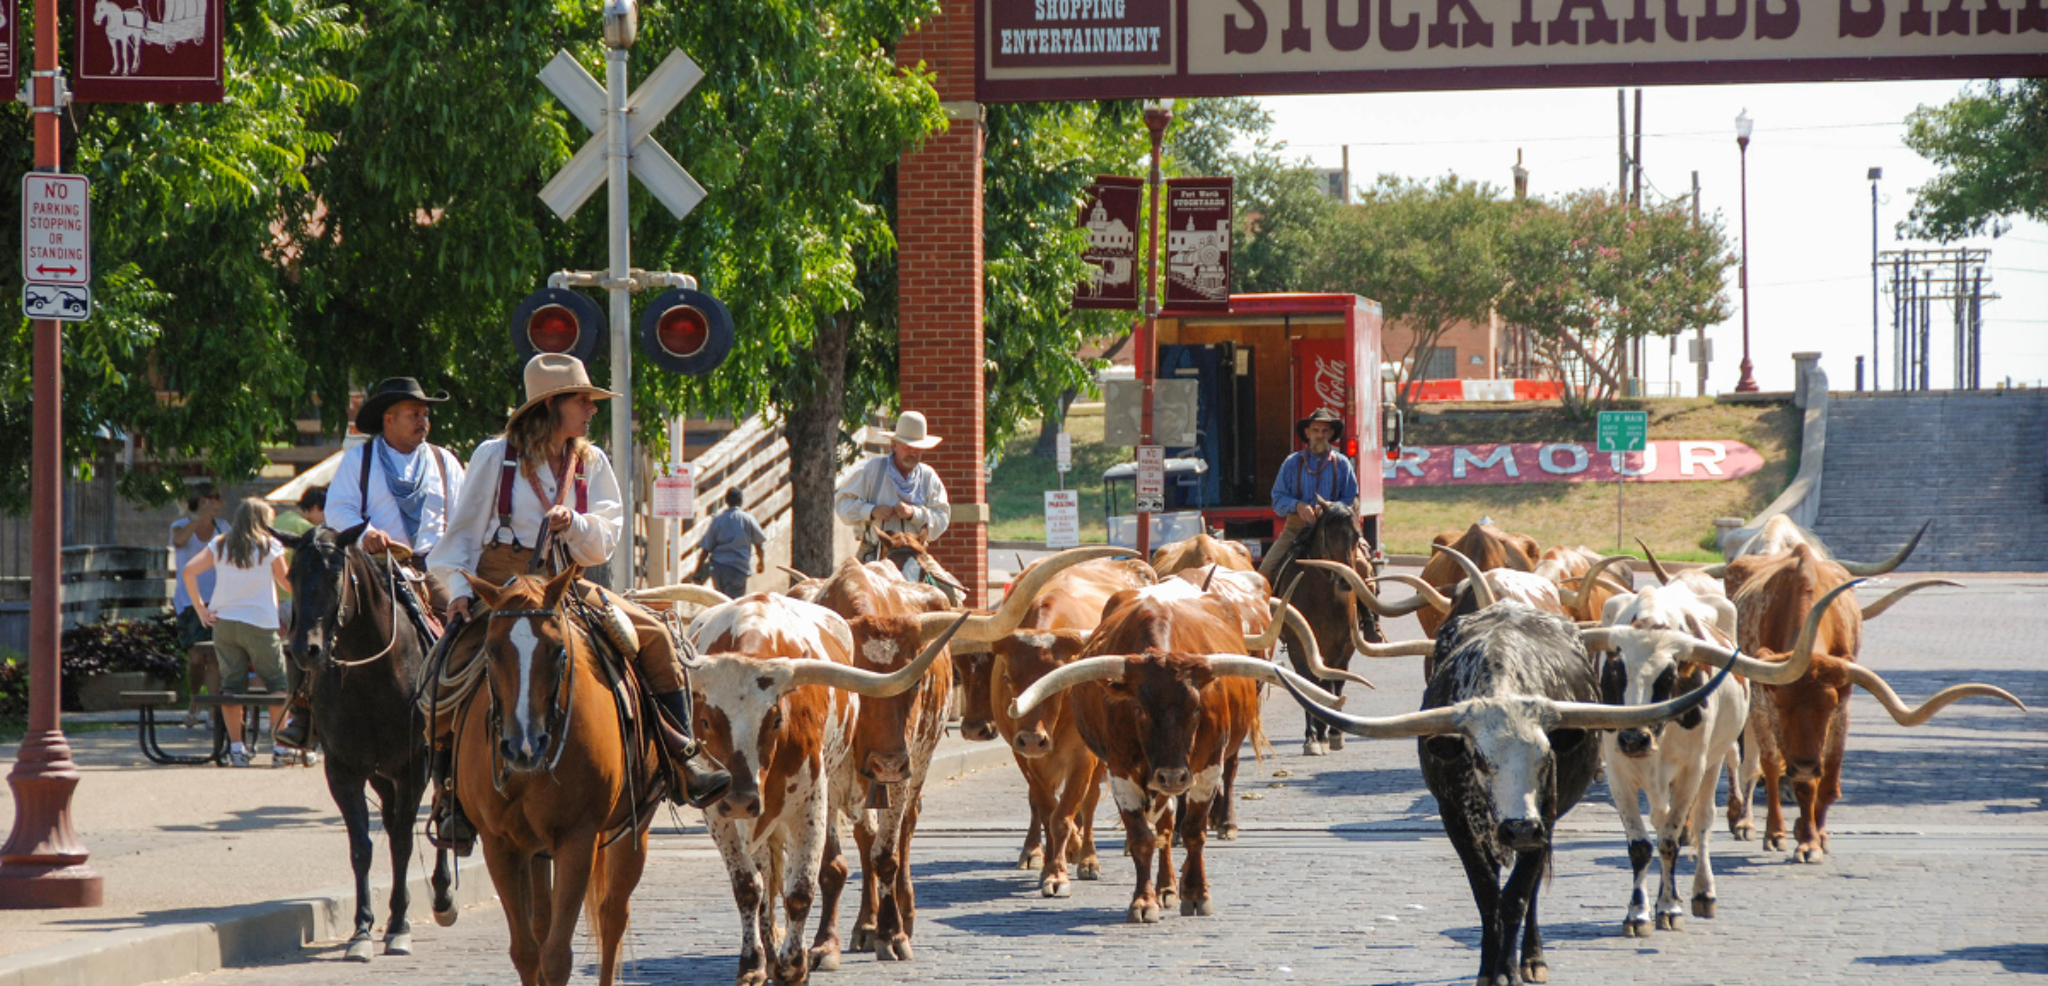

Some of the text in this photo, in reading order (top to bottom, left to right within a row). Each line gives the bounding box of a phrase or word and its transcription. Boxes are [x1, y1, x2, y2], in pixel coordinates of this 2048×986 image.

[1035, 0, 1126, 21] SHOPPING
[1001, 26, 1161, 54] ENTERTAINMENT
[45, 183, 68, 199] NO
[33, 202, 79, 216] PARKING
[1173, 198, 1226, 207] STOCKYARDS
[30, 217, 82, 231] STOPPING
[49, 233, 63, 244] OR
[30, 247, 82, 260] STANDING
[1382, 441, 1727, 479] RMOUR
